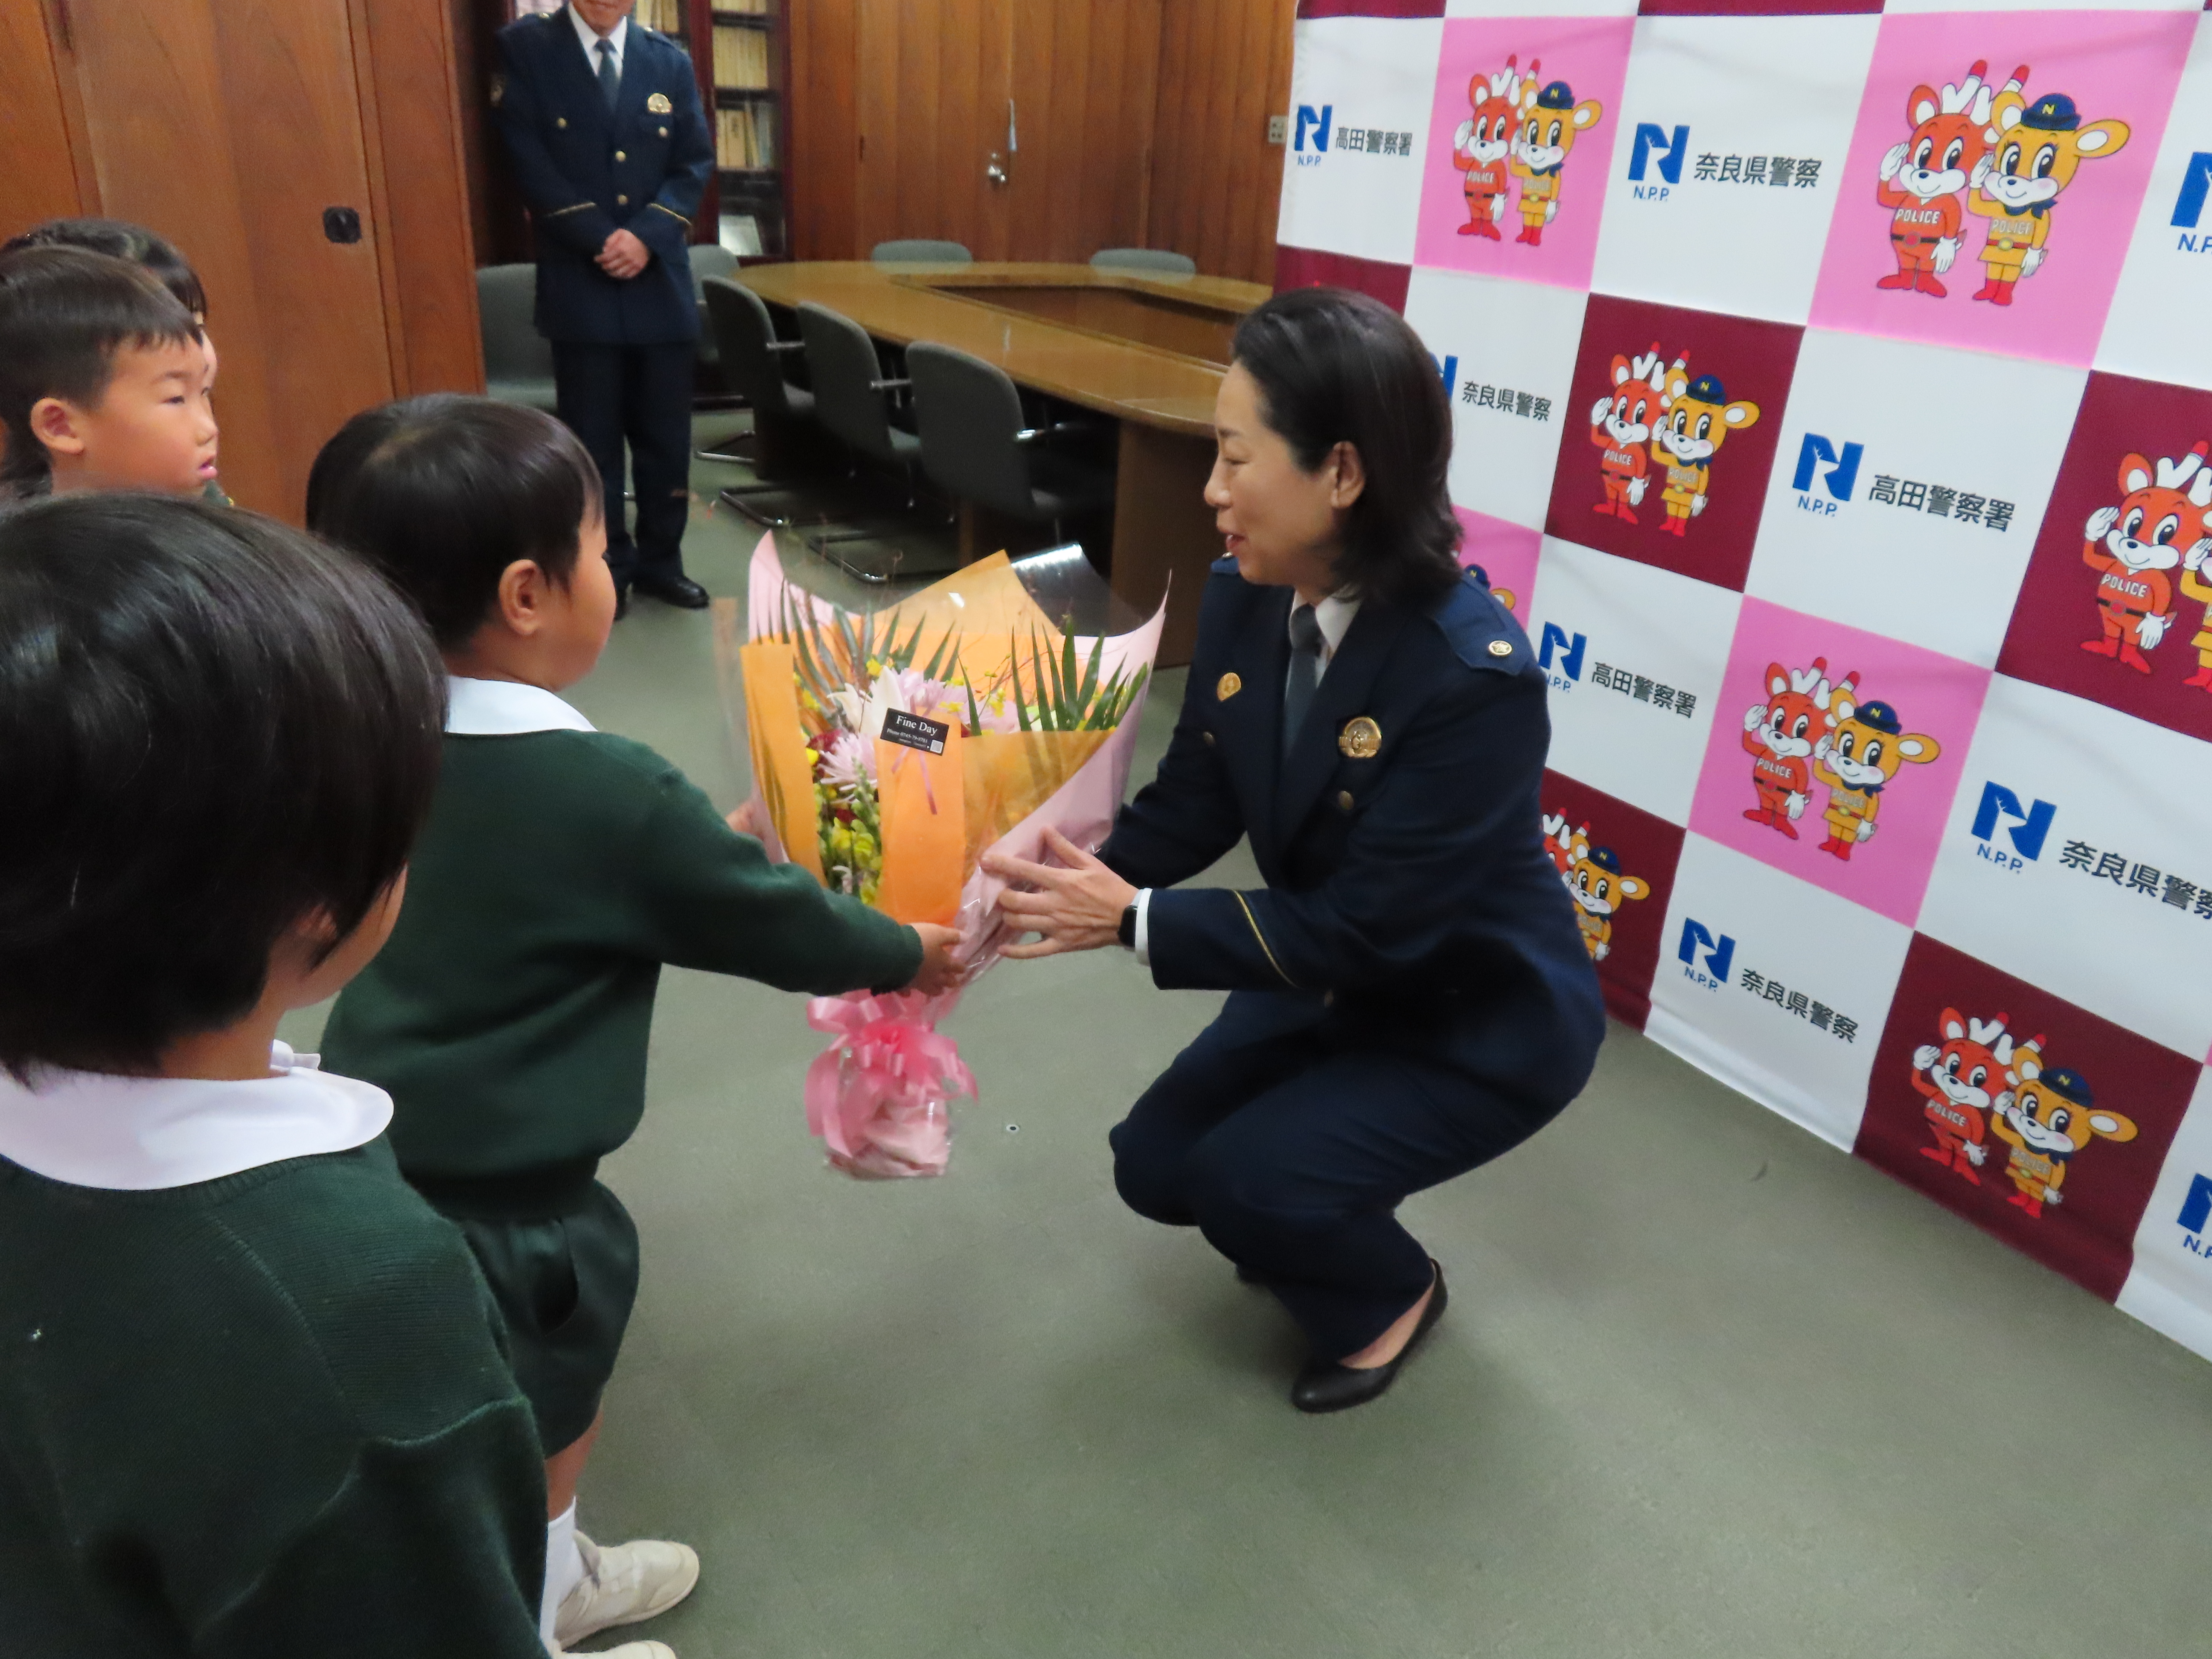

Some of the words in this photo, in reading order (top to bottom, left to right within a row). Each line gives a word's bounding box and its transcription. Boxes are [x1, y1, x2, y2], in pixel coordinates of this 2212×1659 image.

[2042, 103, 2055, 115] N
[1336, 127, 1413, 156] 高田警察署
[1694, 152, 1823, 188] 奈良県警察
[1633, 185, 1669, 201] N.P.P.
[1895, 208, 1941, 224] POLICE
[1462, 381, 1552, 421] 奈良県警察
[1604, 449, 1633, 466] POLICE
[1798, 495, 1838, 517] N.P.P.
[1869, 474, 2016, 533] 高田警察署
[2101, 573, 2148, 597] POLICE
[1592, 661, 1697, 718] 高田警察署
[896, 715, 917, 728] Fine
[919, 722, 937, 736] Day
[1757, 757, 1792, 778] POLICE
[1977, 843, 2023, 875] N.P.P.
[1685, 966, 1718, 992] N.P.P.
[1741, 968, 1858, 1043] 奈良県警察
[1926, 1099, 1968, 1127] POLICE
